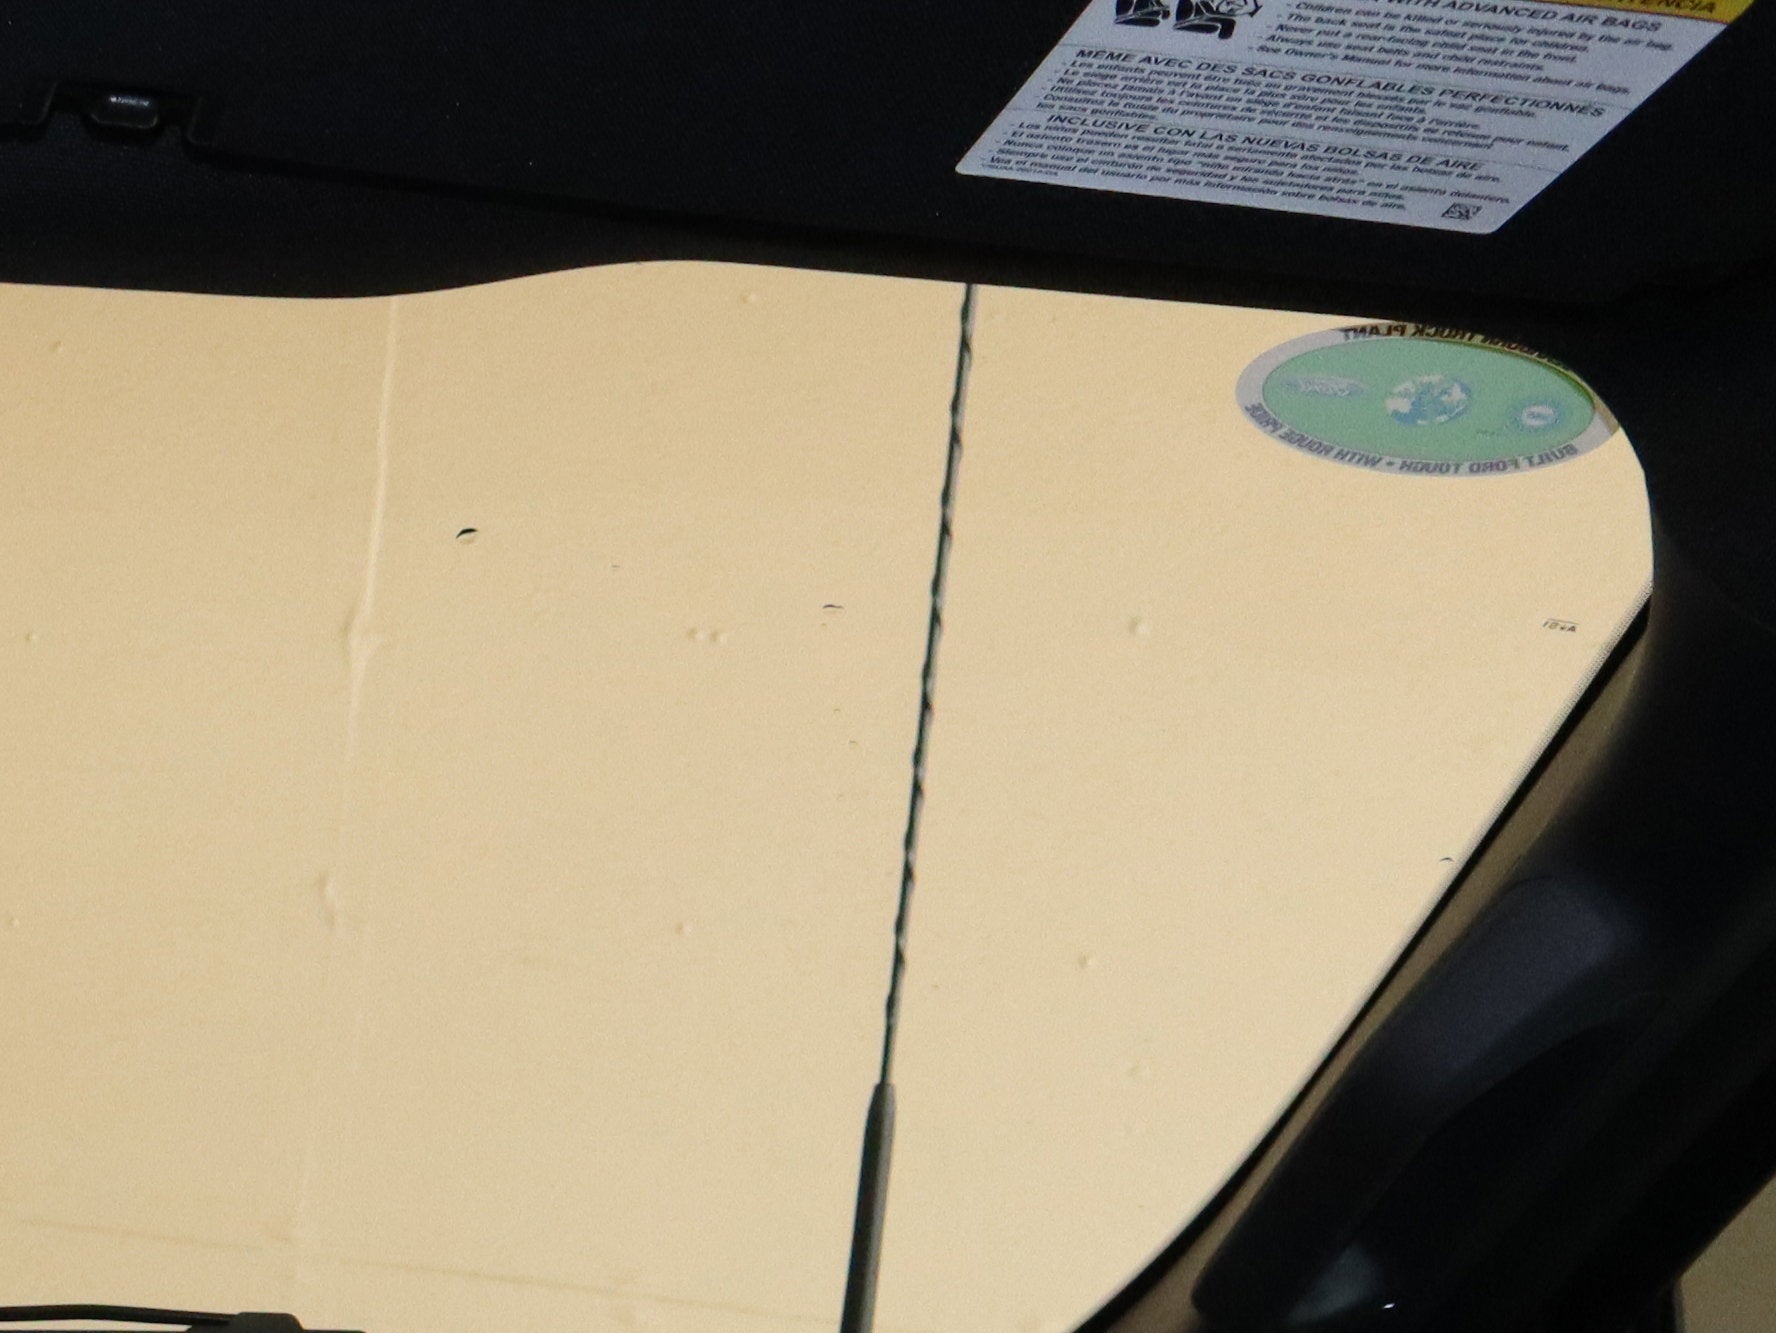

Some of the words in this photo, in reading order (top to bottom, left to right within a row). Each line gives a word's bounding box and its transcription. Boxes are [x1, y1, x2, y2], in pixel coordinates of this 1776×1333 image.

[1449, 0, 1557, 21] ADVANCED
[1562, 11, 1597, 24] AIR
[1600, 16, 1663, 32] BAGS
[1138, 55, 1189, 69] AVEC
[1197, 62, 1238, 74] DES
[1242, 66, 1296, 80] SACS
[1300, 70, 1436, 97] GONFLABLES
[1047, 113, 1150, 133] INCLUSIVE
[1153, 126, 1196, 138] CON
[1199, 131, 1238, 143] LAS
[1241, 136, 1320, 153] NUEVAS
[1322, 144, 1405, 162] BOLSAS
[1406, 154, 1435, 165] DE
[1436, 158, 1483, 172] AIRE
